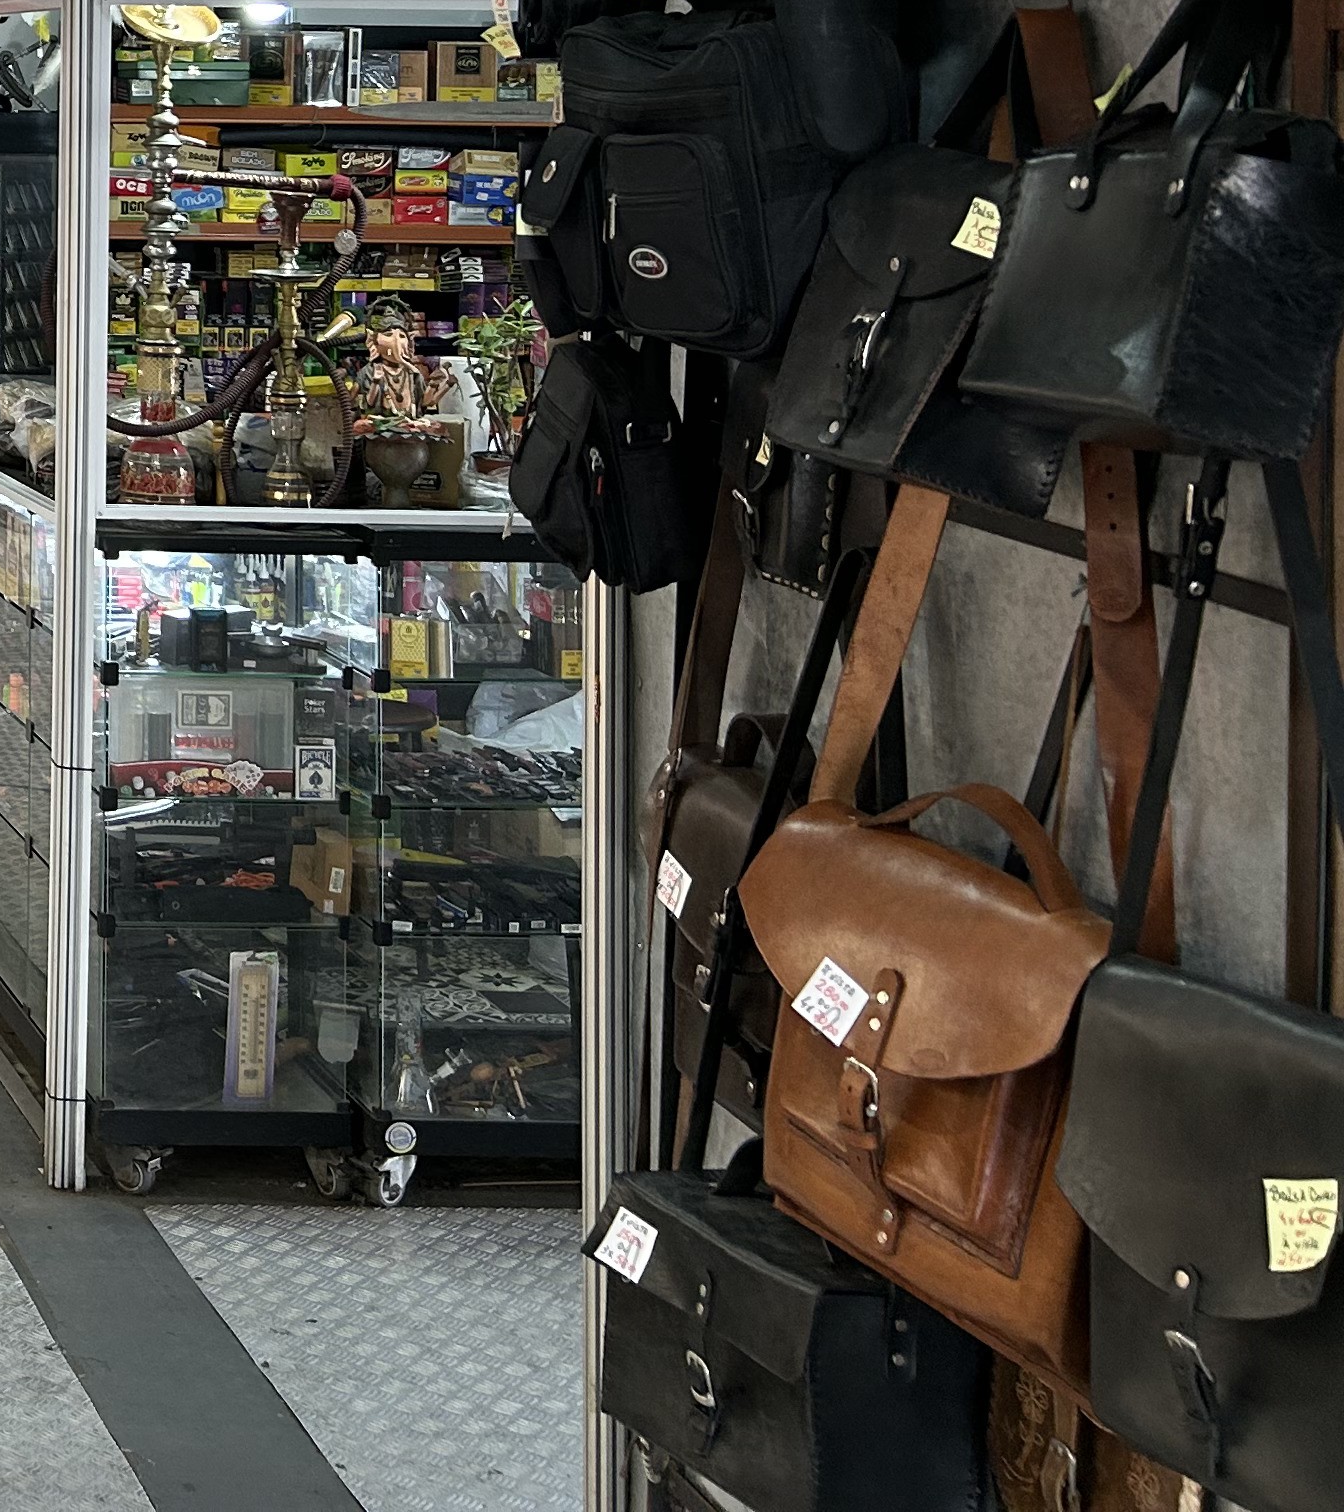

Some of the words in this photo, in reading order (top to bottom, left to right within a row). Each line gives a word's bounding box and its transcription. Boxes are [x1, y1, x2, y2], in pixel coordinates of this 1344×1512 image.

[341, 150, 386, 169] Smoking
[115, 178, 148, 194] OCB
[303, 698, 326, 707] Poker
[303, 705, 326, 714] Stars
[301, 750, 331, 763] BICYCLE
